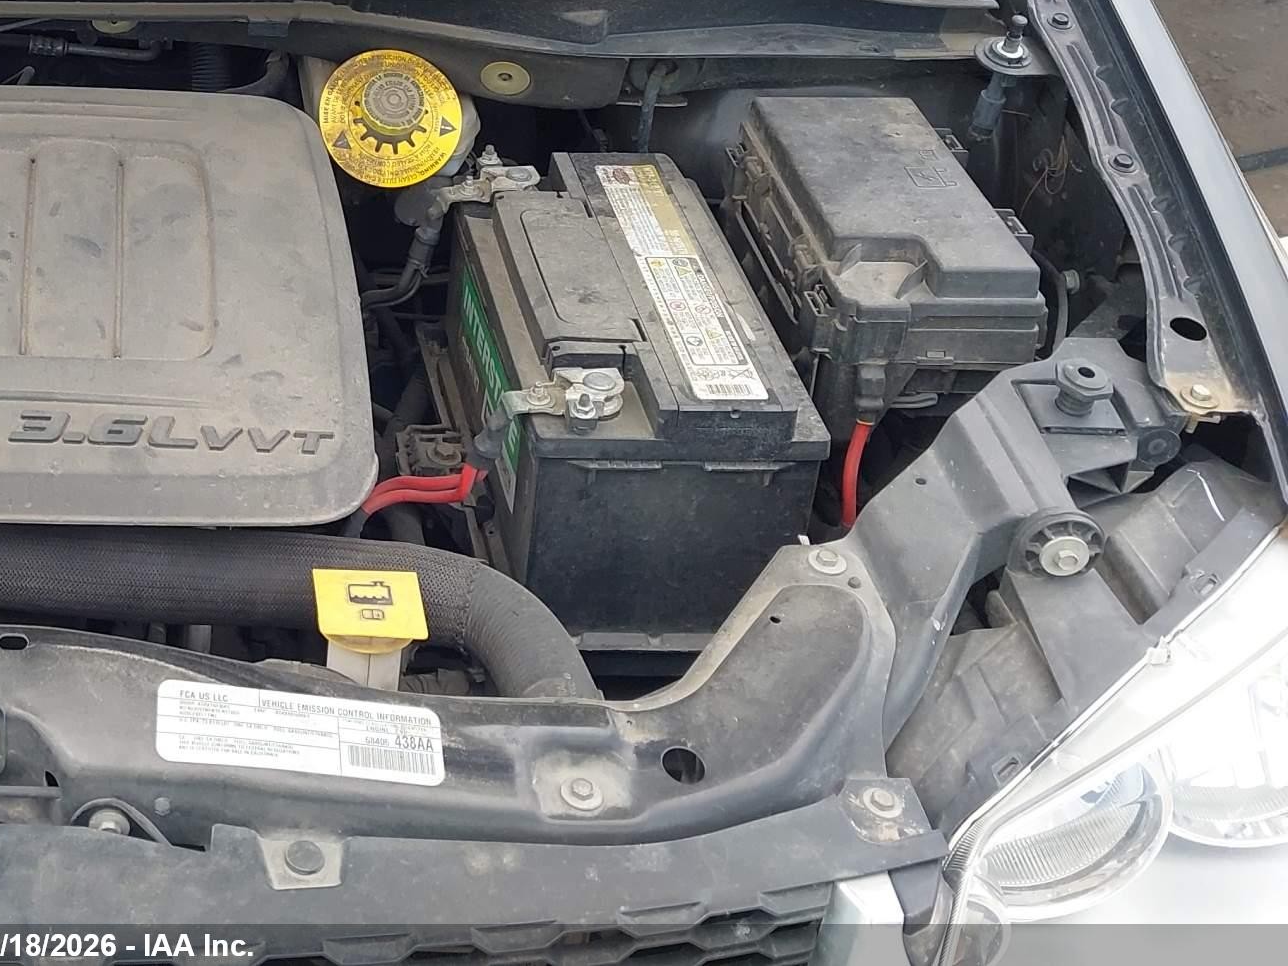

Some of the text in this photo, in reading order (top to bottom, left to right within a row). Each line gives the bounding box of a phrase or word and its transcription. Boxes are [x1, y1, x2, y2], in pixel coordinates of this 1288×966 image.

[180, 690, 229, 702] FCA US LLC
[261, 699, 294, 710] VEHICLE
[297, 702, 335, 716] EMISSION
[338, 708, 374, 719] CONTROL
[376, 712, 432, 726] INFORMATION
[394, 735, 434, 752] 438AA
